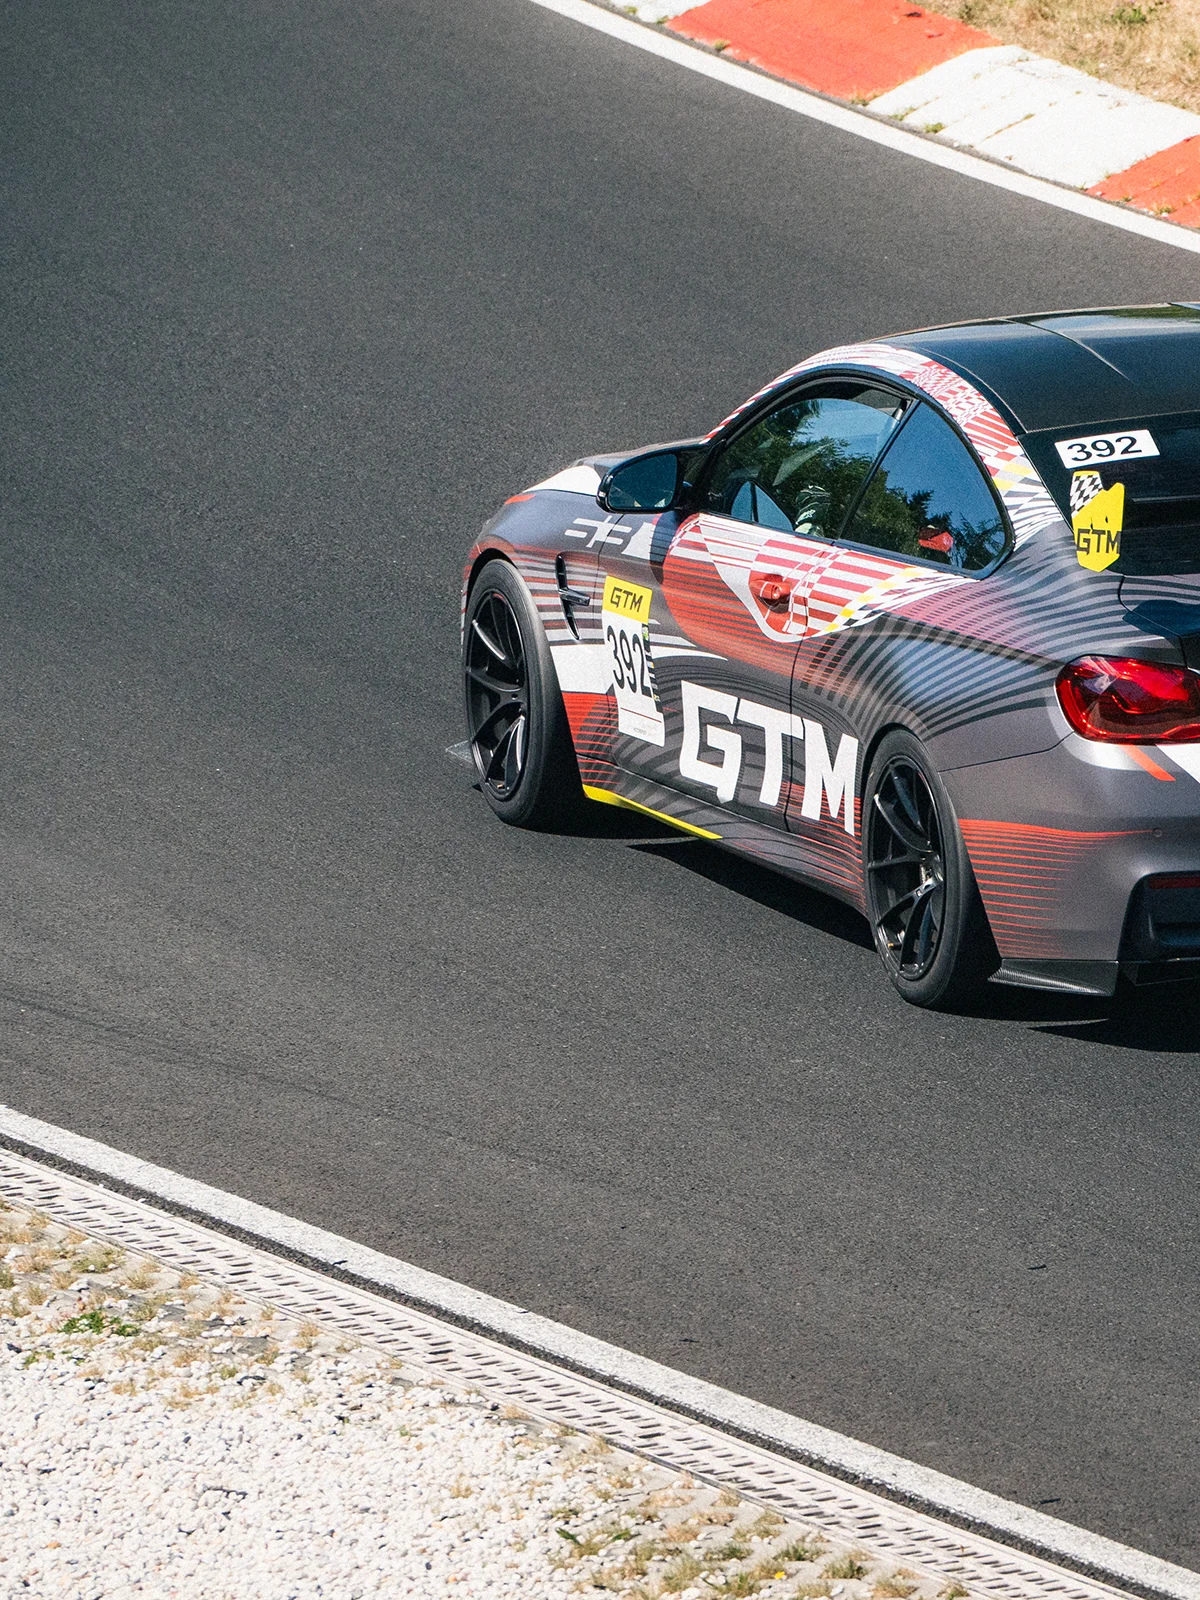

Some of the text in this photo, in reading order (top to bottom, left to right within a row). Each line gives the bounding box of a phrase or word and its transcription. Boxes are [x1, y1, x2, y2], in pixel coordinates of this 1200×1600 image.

[1066, 435, 1143, 462] 392
[1076, 527, 1122, 556] GTM
[610, 586, 644, 613] GTM
[606, 624, 653, 699] 392
[679, 680, 860, 837] GTM
